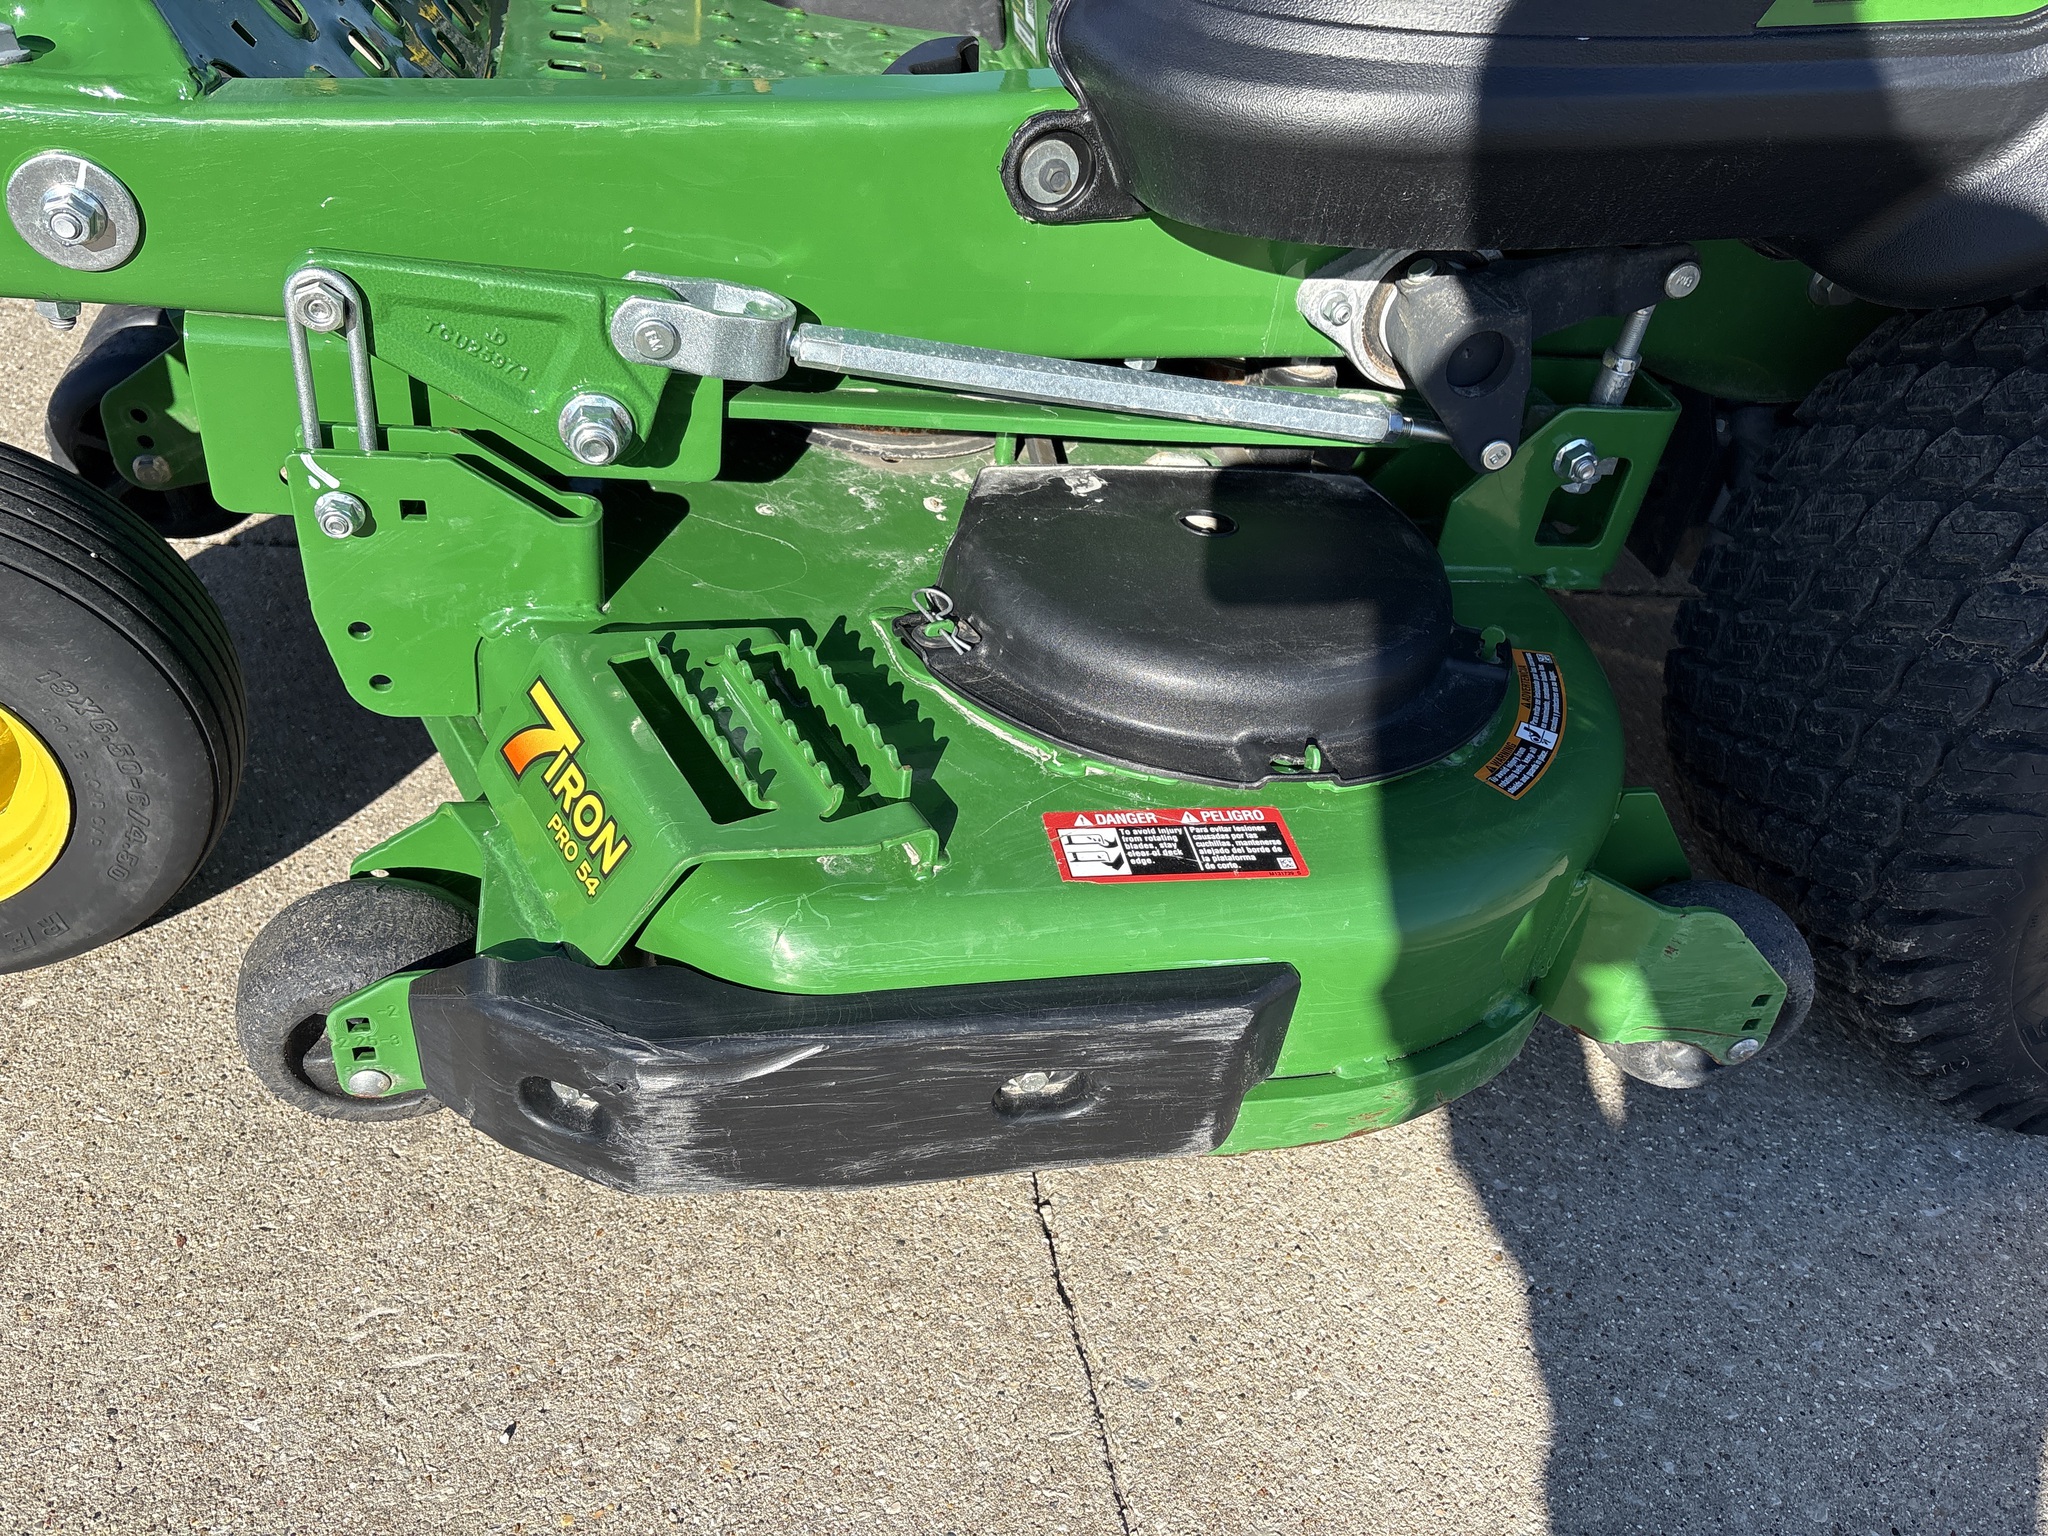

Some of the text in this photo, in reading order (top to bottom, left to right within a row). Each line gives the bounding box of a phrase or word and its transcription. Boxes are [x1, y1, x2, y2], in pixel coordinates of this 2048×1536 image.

[1518, 665, 1530, 702] ADVERTENCIA
[1490, 742, 1516, 766] WARNING
[1094, 812, 1158, 825] DANGER
[1200, 810, 1264, 822] PELIGRO
[546, 812, 578, 862] PRO
[1158, 827, 1183, 835] injury
[1142, 835, 1178, 843] rotating
[1212, 854, 1256, 862] plataforma
[576, 858, 600, 897] 54
